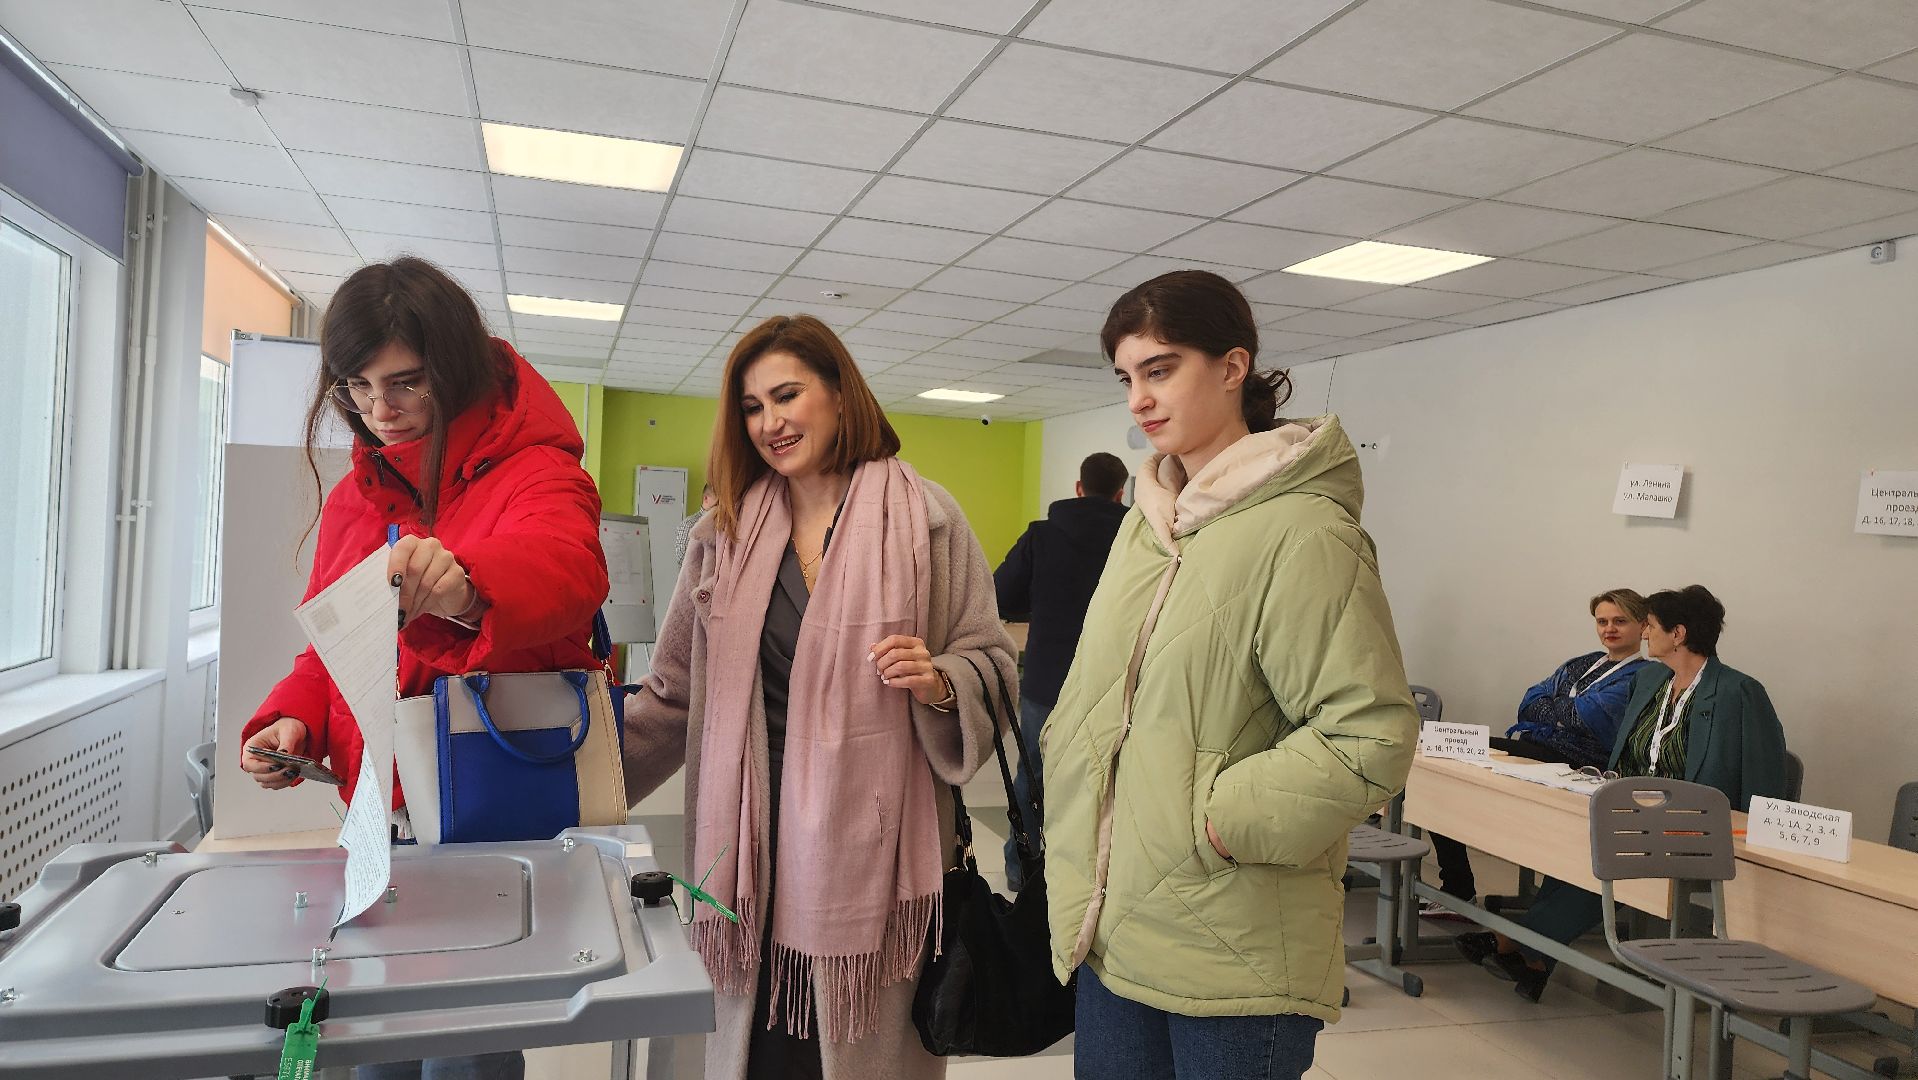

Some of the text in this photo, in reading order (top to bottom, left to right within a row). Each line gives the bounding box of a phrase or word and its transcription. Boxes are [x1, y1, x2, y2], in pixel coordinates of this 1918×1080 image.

[1630, 479, 1671, 489] ул. Ленина
[1874, 516, 1886, 525] 16,
[1889, 517, 1901, 527] 17,
[1434, 726, 1479, 736] Центральный
[1444, 737, 1468, 745] проезд
[1477, 748, 1486, 756] 22
[1785, 804, 1840, 823] Заводская
[1763, 817, 1773, 826] д.
[1777, 818, 1785, 828] 1,
[1805, 823, 1814, 833] 2,
[1818, 825, 1826, 835] 3,
[1829, 828, 1838, 838] 4,
[1780, 831, 1820, 846] 5, 6, 7, 9
